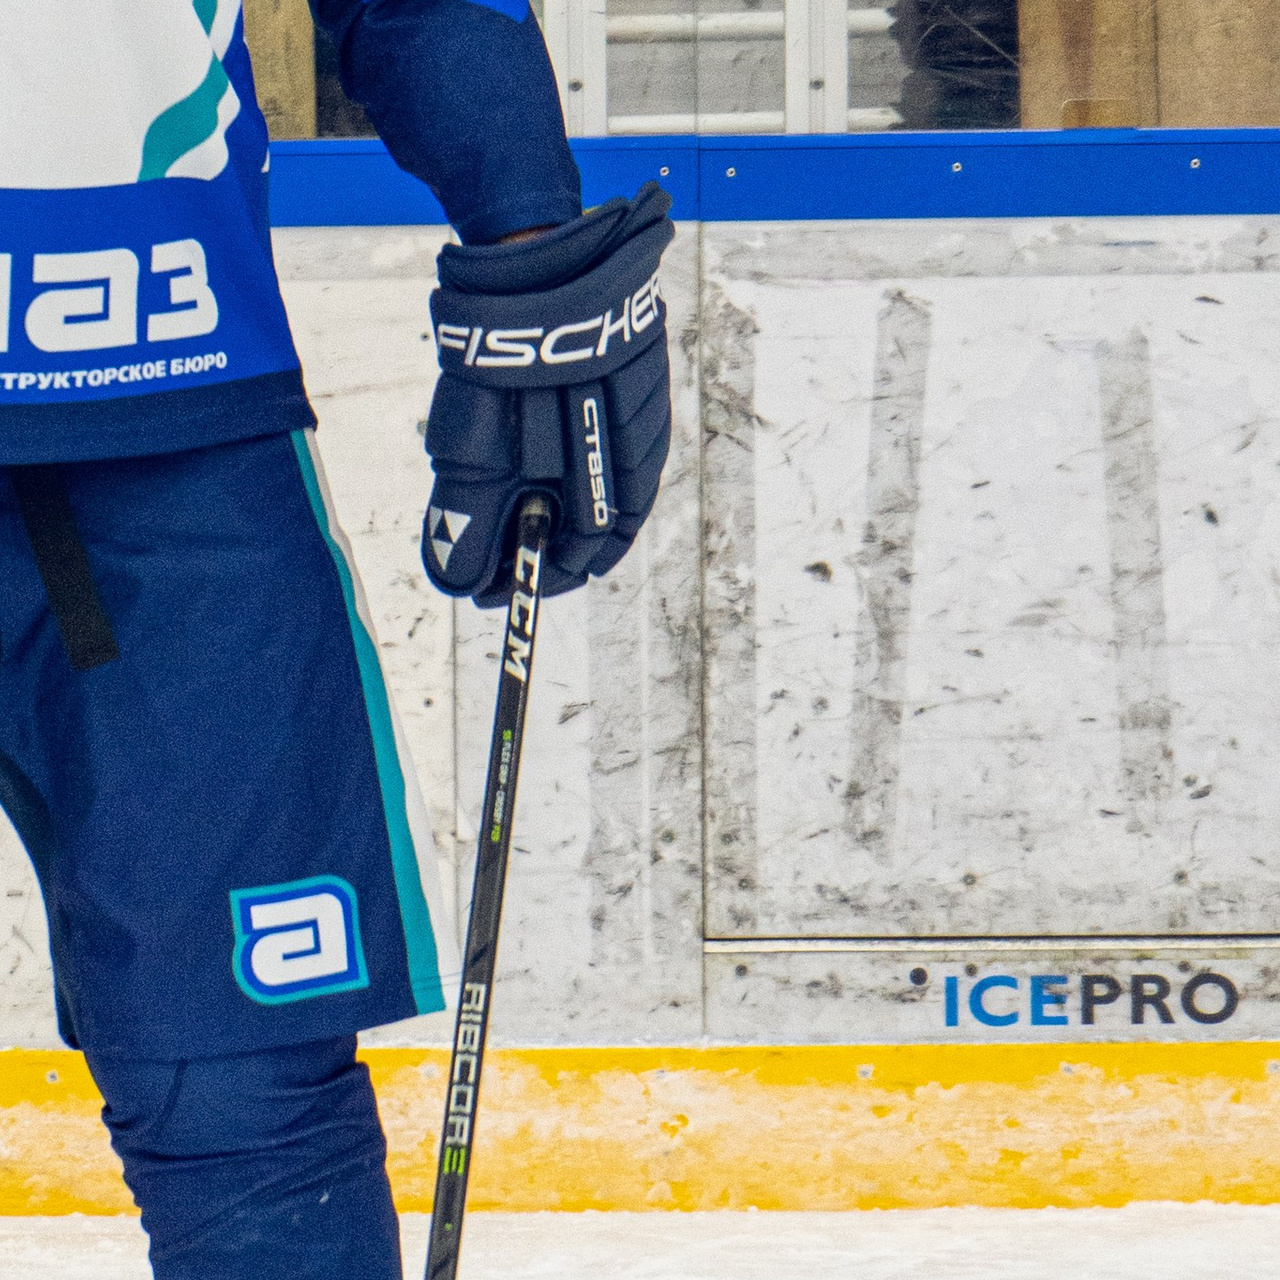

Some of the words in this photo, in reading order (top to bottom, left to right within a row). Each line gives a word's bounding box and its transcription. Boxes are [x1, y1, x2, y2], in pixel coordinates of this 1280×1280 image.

[169, 352, 228, 376] БЮРО
[438, 268, 664, 368] FISCHER
[583, 397, 608, 526] CT850
[504, 545, 540, 683] CCM
[944, 972, 1240, 1027] ICEPRO
[442, 981, 487, 1175] RIBCORE
